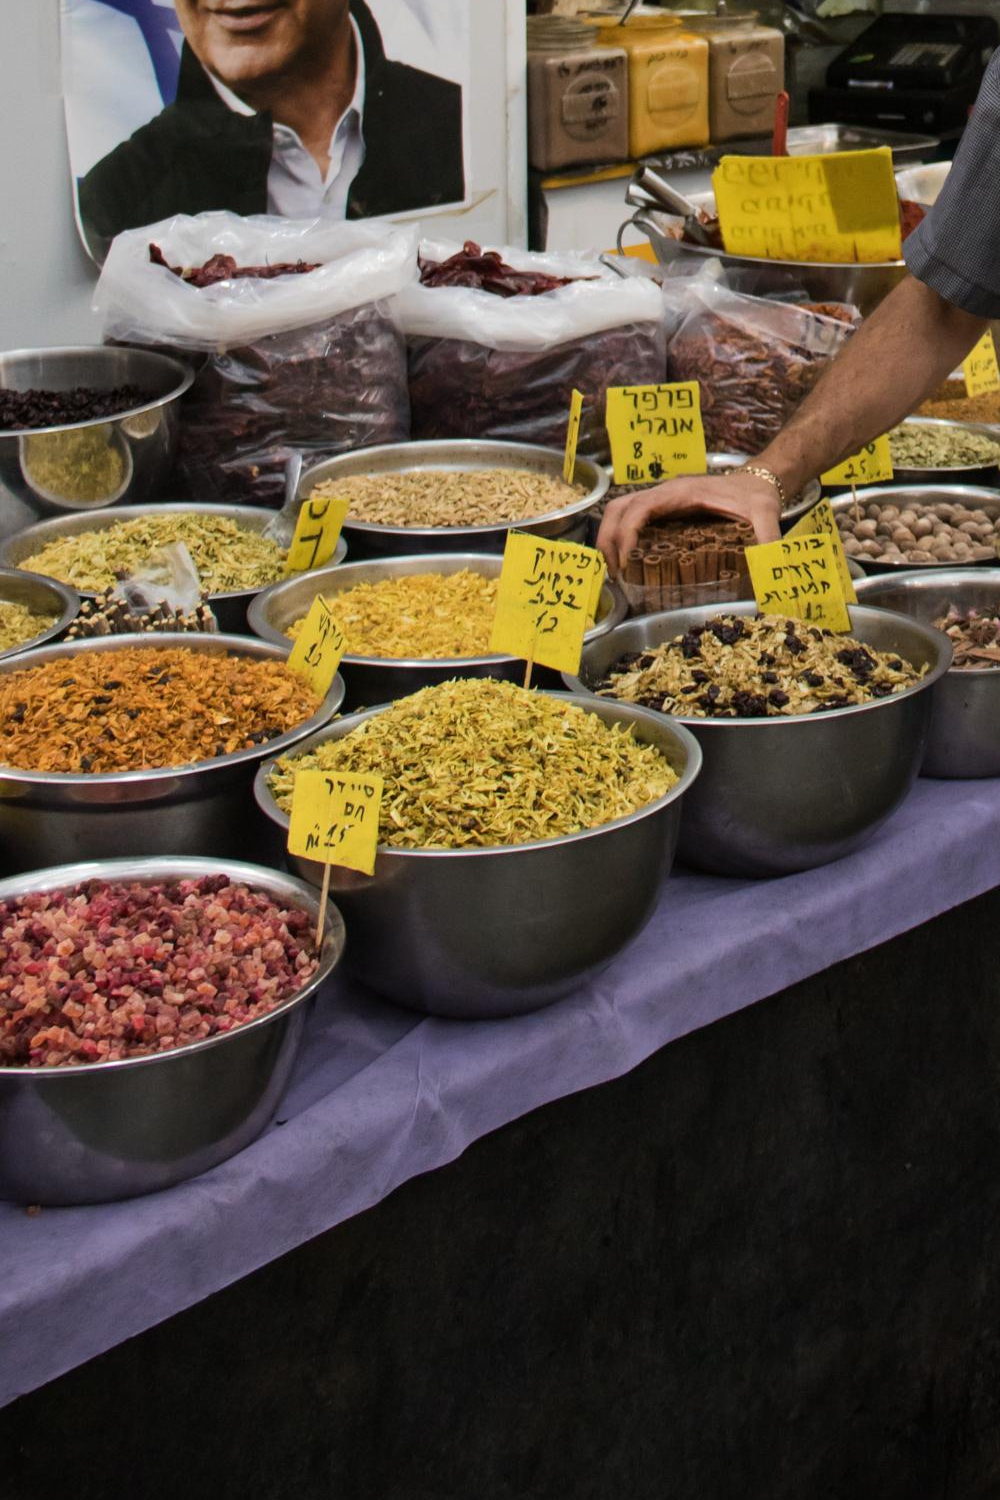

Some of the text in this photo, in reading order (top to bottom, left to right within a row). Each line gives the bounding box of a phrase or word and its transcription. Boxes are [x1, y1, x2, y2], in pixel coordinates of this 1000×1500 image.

[623, 386, 693, 411] פלפל
[629, 413, 693, 436] אנגלי
[633, 441, 643, 459] 8
[325, 778, 374, 797] סיידר
[344, 802, 365, 822] חם
